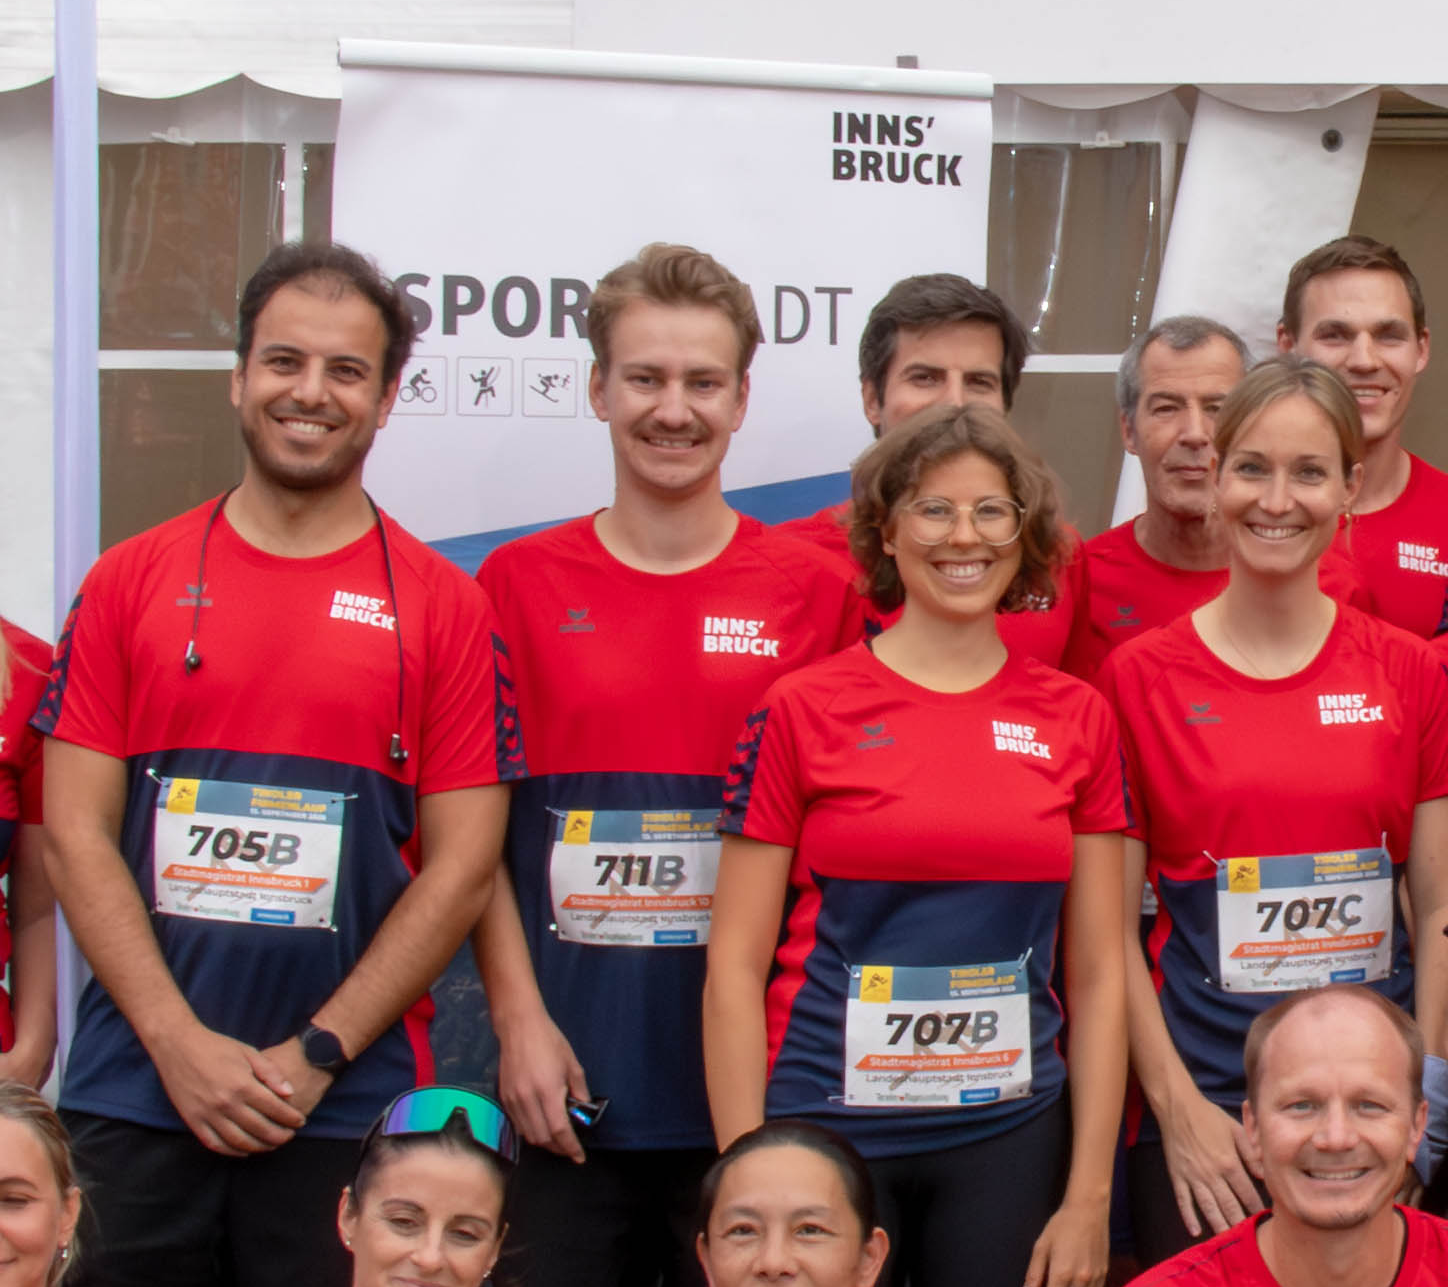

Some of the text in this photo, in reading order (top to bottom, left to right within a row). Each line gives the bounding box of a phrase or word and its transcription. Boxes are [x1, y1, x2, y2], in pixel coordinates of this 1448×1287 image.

[831, 111, 936, 149] INNS'
[831, 147, 963, 188] BRUCK
[329, 604, 396, 631] BRUCK
[703, 635, 779, 658] BRUCK
[1320, 705, 1384, 726] BRUCK
[994, 735, 1052, 759] BRUCK
[188, 825, 301, 866] 705B
[173, 867, 247, 883] Stadtmagistrat
[249, 875, 302, 887] Innsbruck
[594, 855, 685, 887] 711B
[1256, 894, 1364, 933] 707C
[1243, 940, 1320, 955] Stadtmagistrat
[1322, 938, 1365, 948] Innsbruck
[885, 1010, 999, 1046] 707B
[869, 1056, 951, 1069] Stadtmagistrat
[953, 1054, 1001, 1066] Innsbruck
